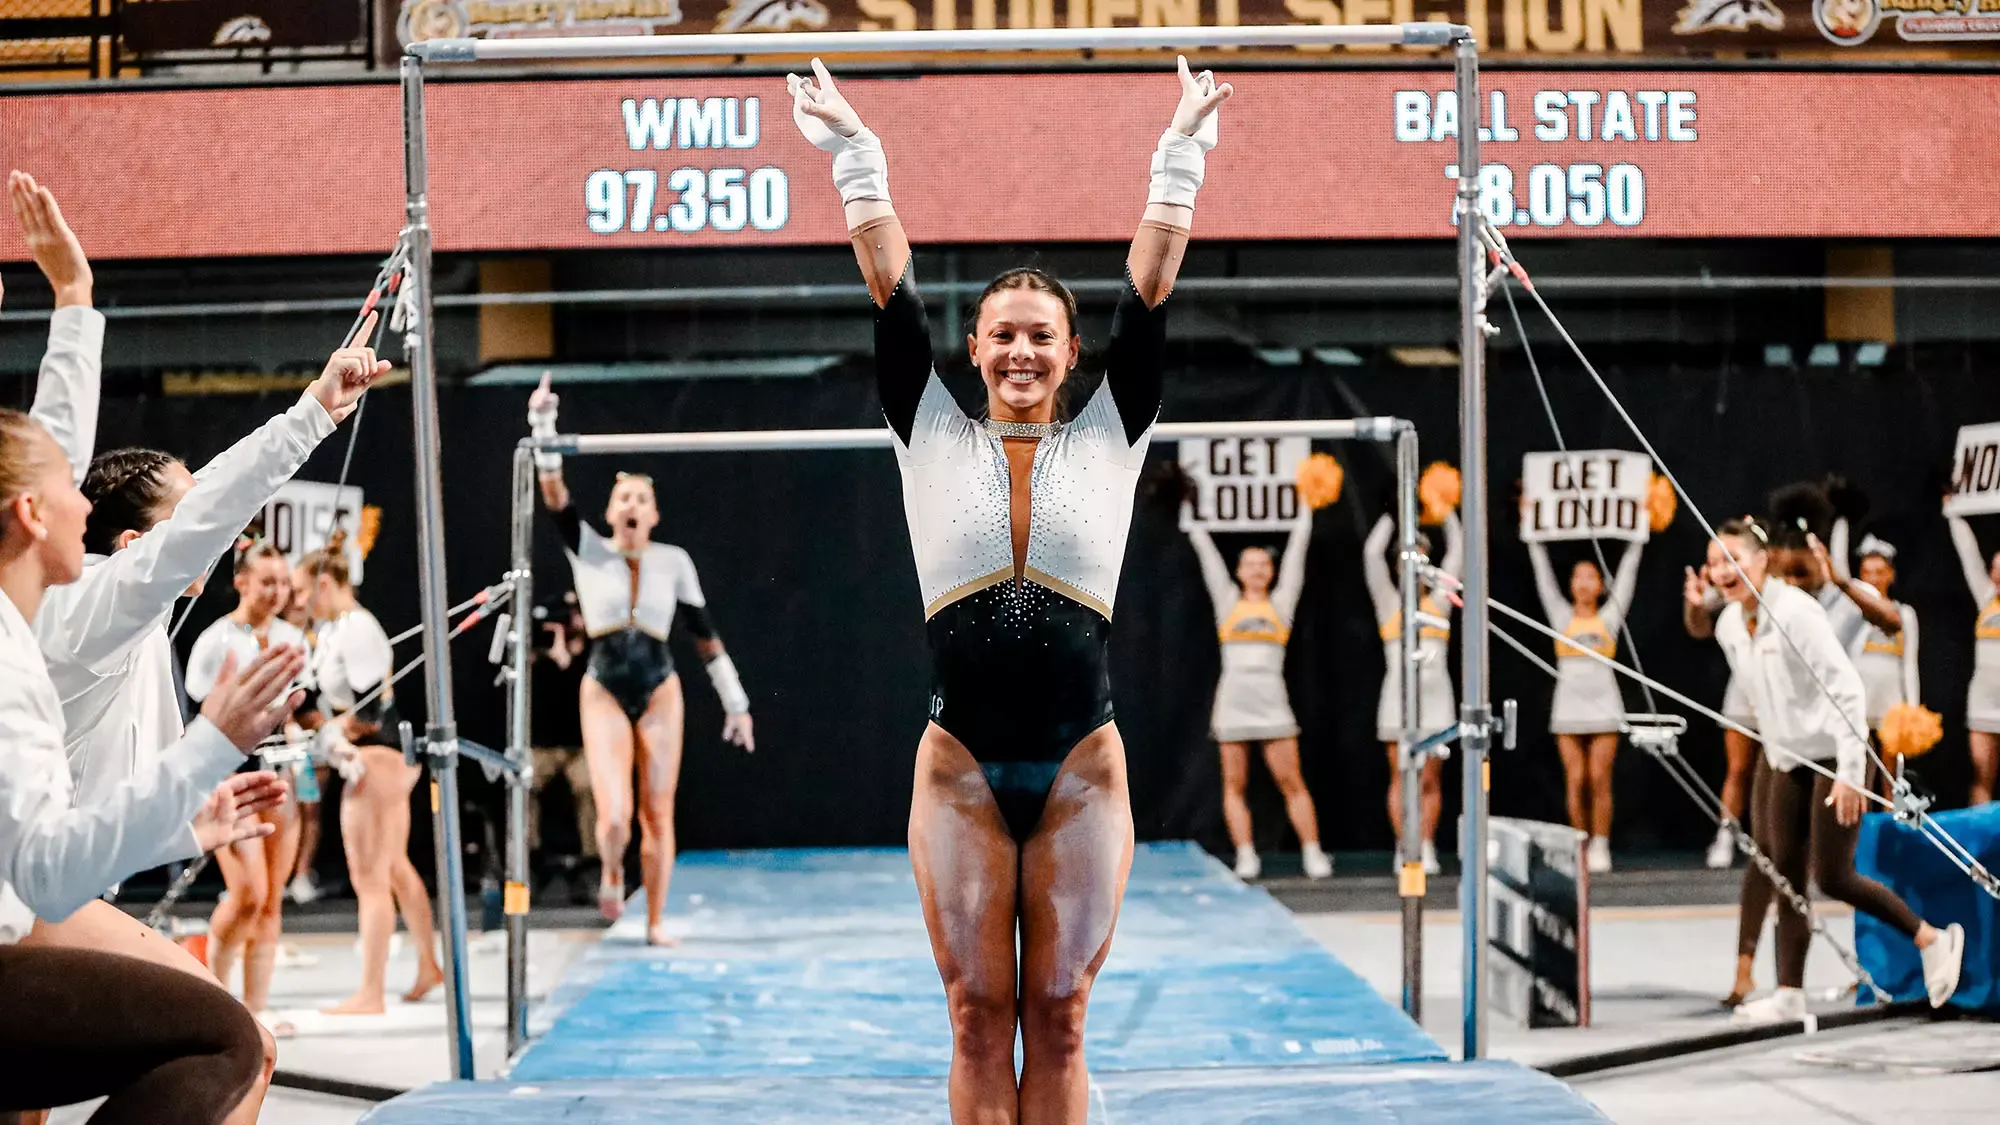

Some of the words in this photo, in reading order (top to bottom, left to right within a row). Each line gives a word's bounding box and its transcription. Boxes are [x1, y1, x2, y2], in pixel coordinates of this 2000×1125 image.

[1284, 0, 1643, 52] SECION
[621, 97, 760, 150] WMU
[1394, 90, 1519, 142] BAL
[1534, 90, 1699, 142] STATE
[585, 167, 789, 233] 97.350
[1210, 438, 1280, 476] GET
[1553, 459, 1623, 490] GET
[1958, 444, 2000, 493] NO
[1193, 484, 1299, 520] LOUD
[1534, 498, 1638, 530] LOUD
[249, 502, 349, 553] OIS
